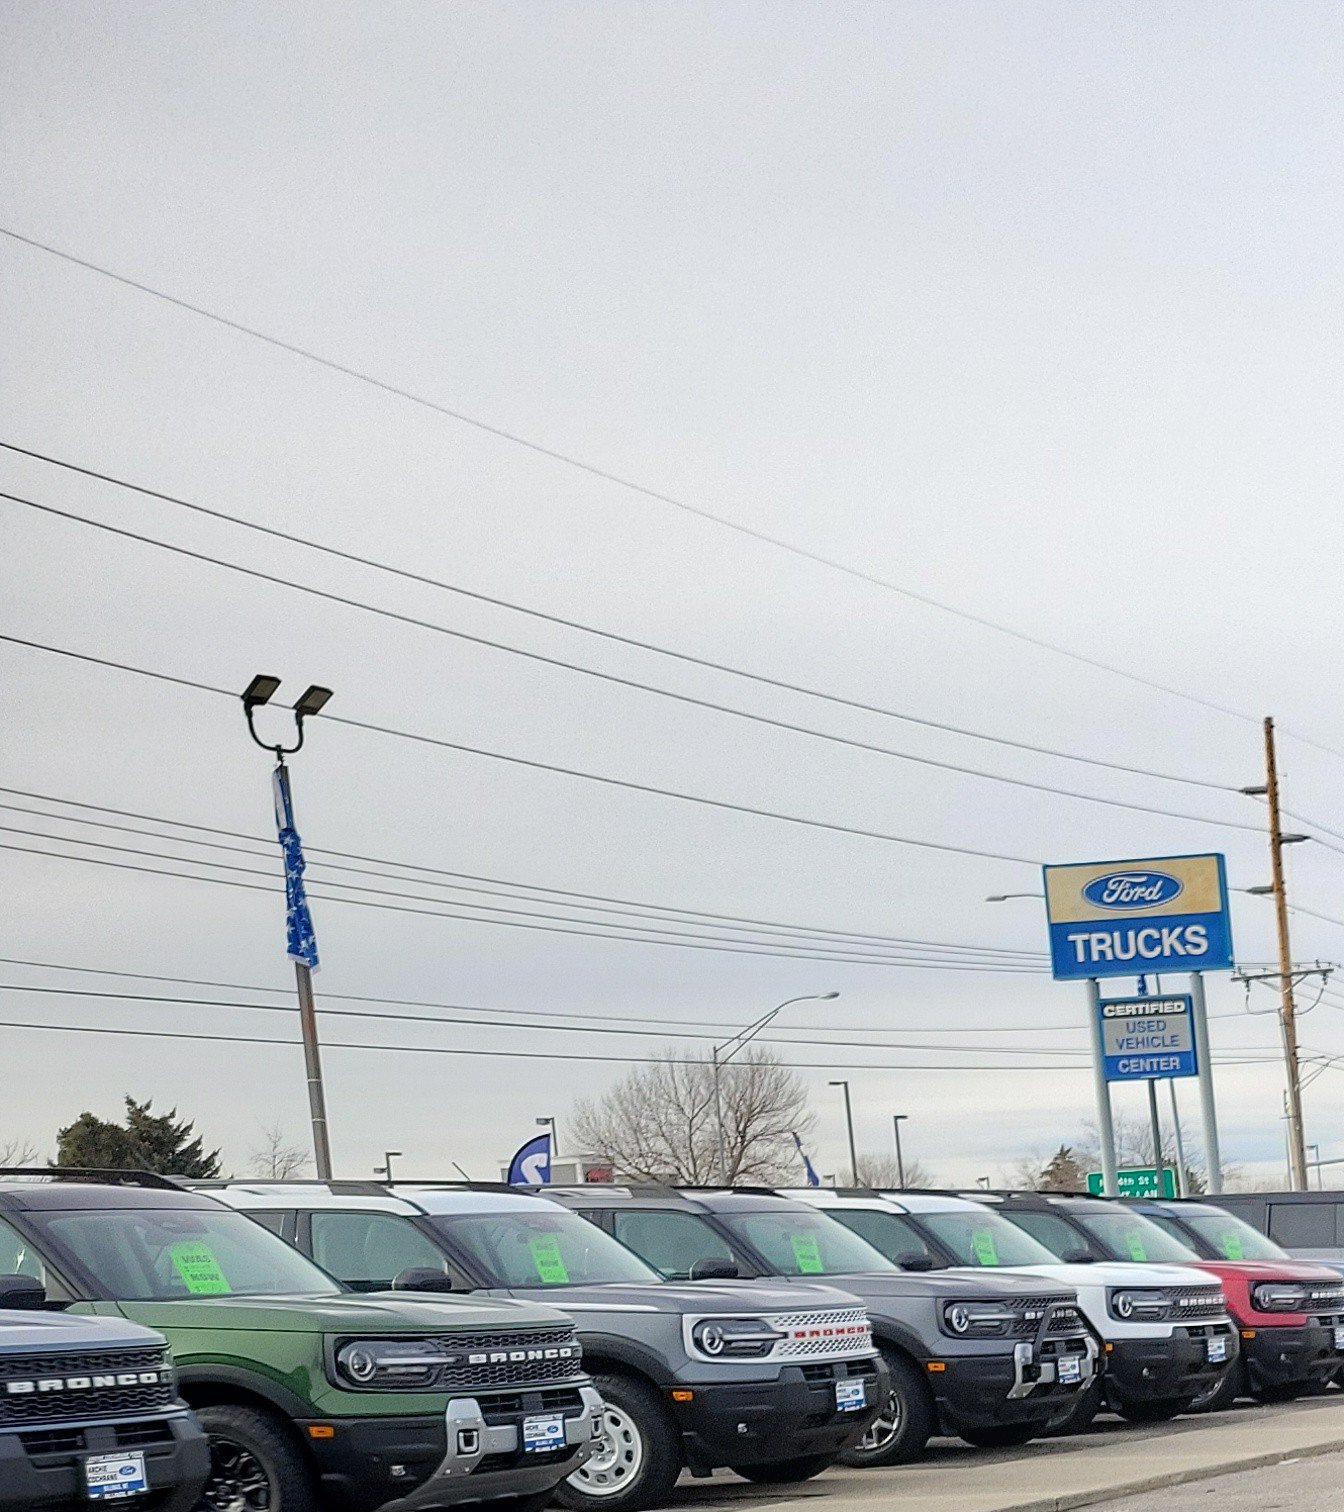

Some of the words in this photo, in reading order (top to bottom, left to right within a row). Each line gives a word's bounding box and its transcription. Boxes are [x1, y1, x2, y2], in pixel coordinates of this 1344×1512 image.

[1103, 875, 1163, 904] Ford
[1067, 924, 1209, 963] TRUCKS
[1103, 1000, 1186, 1017] CERTIFIED
[1126, 1020, 1167, 1034] USED
[1115, 1034, 1180, 1050] VEHICLE
[1118, 1056, 1181, 1074] CENTER
[794, 1326, 866, 1339] BRONCO
[468, 1347, 572, 1364] BRONCO
[6, 1372, 159, 1394] BRONCO
